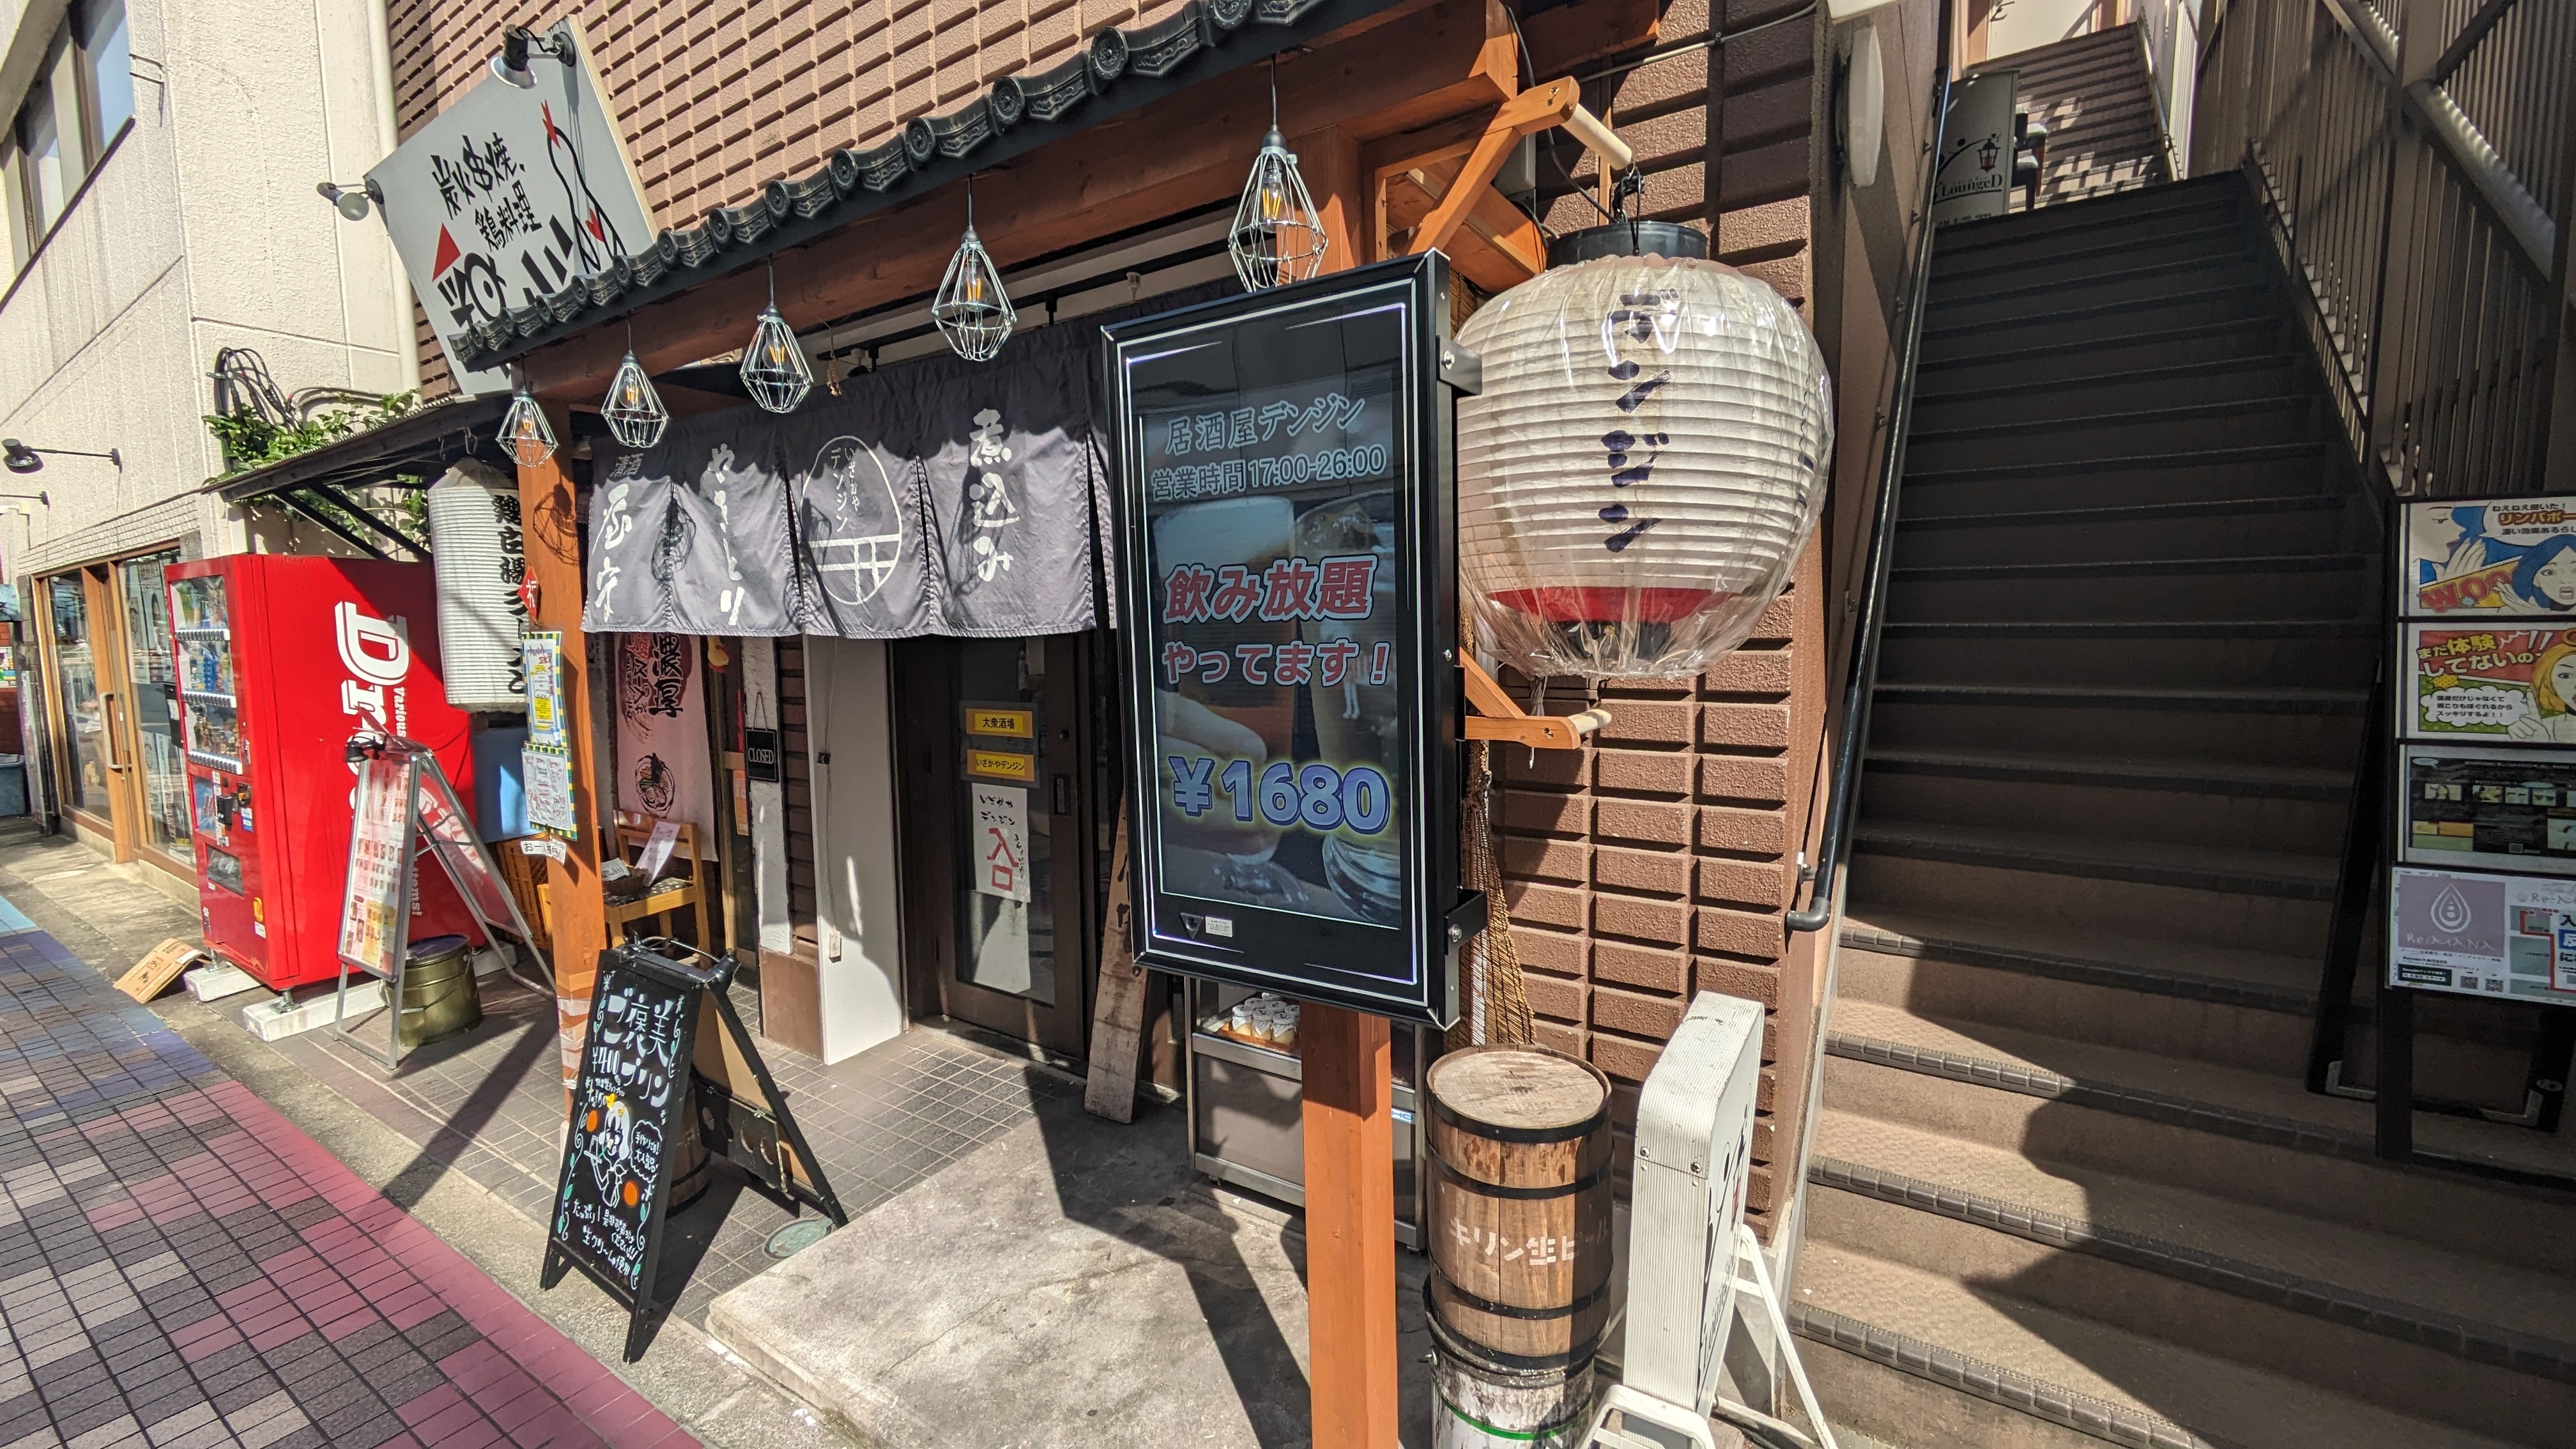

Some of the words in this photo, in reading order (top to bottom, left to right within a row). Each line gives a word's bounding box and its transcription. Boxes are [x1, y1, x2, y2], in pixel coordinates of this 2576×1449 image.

[1165, 393, 1365, 456] 居酒屋デンジン
[831, 447, 848, 533] デンジン
[845, 447, 860, 512] いざかや
[969, 408, 1020, 582] 煮込み
[1163, 555, 1378, 624] 飲み放題
[2416, 634, 2497, 659] まだ体験
[983, 717, 1015, 730] 大衆酒場
[747, 746, 774, 765] CLOSED
[976, 758, 1024, 770] いざかやデンジン
[1169, 756, 1390, 836] ¥1680
[986, 828, 1019, 891] 入口
[604, 988, 673, 1067] ご褒美
[621, 1057, 670, 1107] プリン
